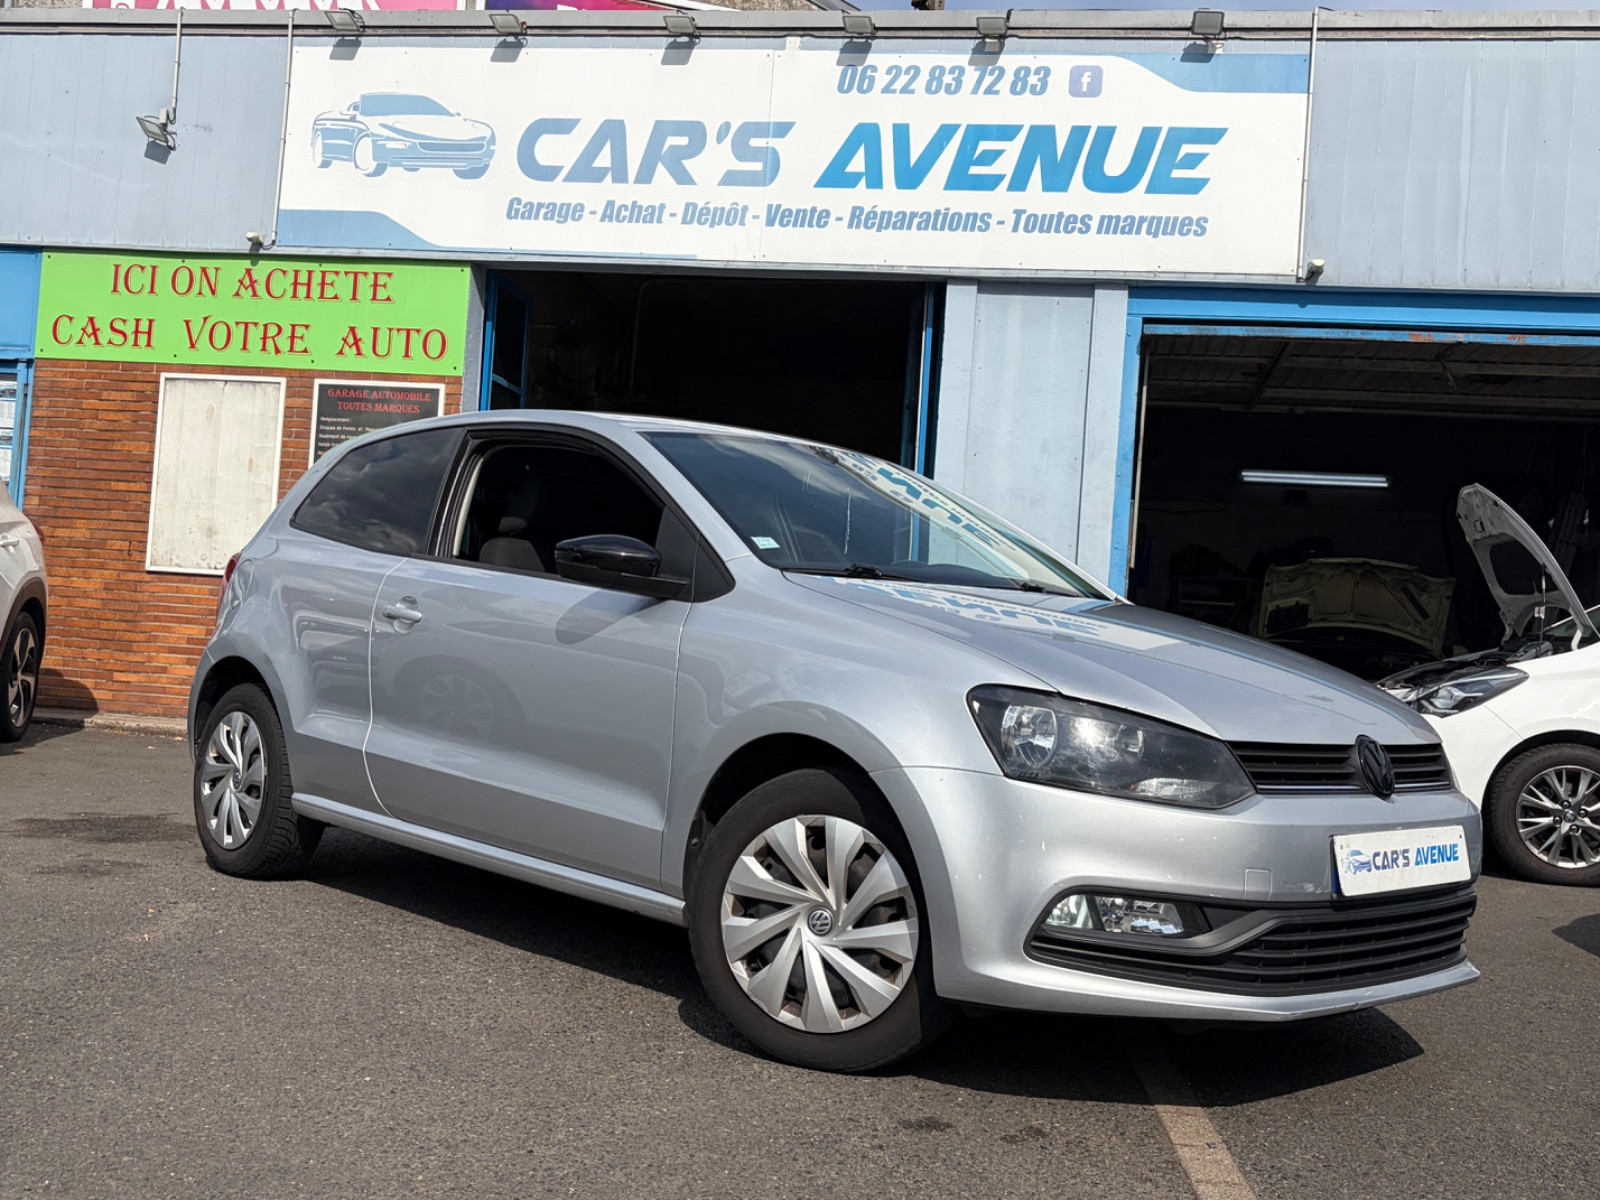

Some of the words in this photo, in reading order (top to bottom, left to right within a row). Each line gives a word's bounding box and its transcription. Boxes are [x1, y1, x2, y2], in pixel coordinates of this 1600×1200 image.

[837, 64, 878, 95] 06
[880, 64, 920, 95] 22
[924, 64, 965, 96] 83
[971, 64, 1007, 96] 72
[1009, 65, 1051, 96] 83
[517, 117, 797, 187] CAR'S
[813, 122, 1229, 195] AVENUE
[506, 197, 585, 224] Garage
[600, 200, 666, 225] Achat
[681, 201, 749, 228] Dépôt
[765, 204, 830, 228] Vente
[847, 205, 992, 233] Réparations
[1010, 209, 1091, 235] Toutes
[1096, 213, 1209, 238] marques
[111, 263, 158, 295] ICI
[171, 265, 221, 298] ON
[233, 268, 394, 303] ACHETE
[52, 314, 155, 349] CASH
[183, 314, 312, 356] VOTRE
[335, 325, 448, 361] AUTO
[328, 388, 369, 398] GARAGE
[371, 390, 431, 402] AUTOMOBILE
[337, 402, 372, 411] TOUTES
[375, 403, 420, 413] MARQUES
[1372, 848, 1410, 871] CAR'S
[1414, 843, 1460, 866] AVENUE
